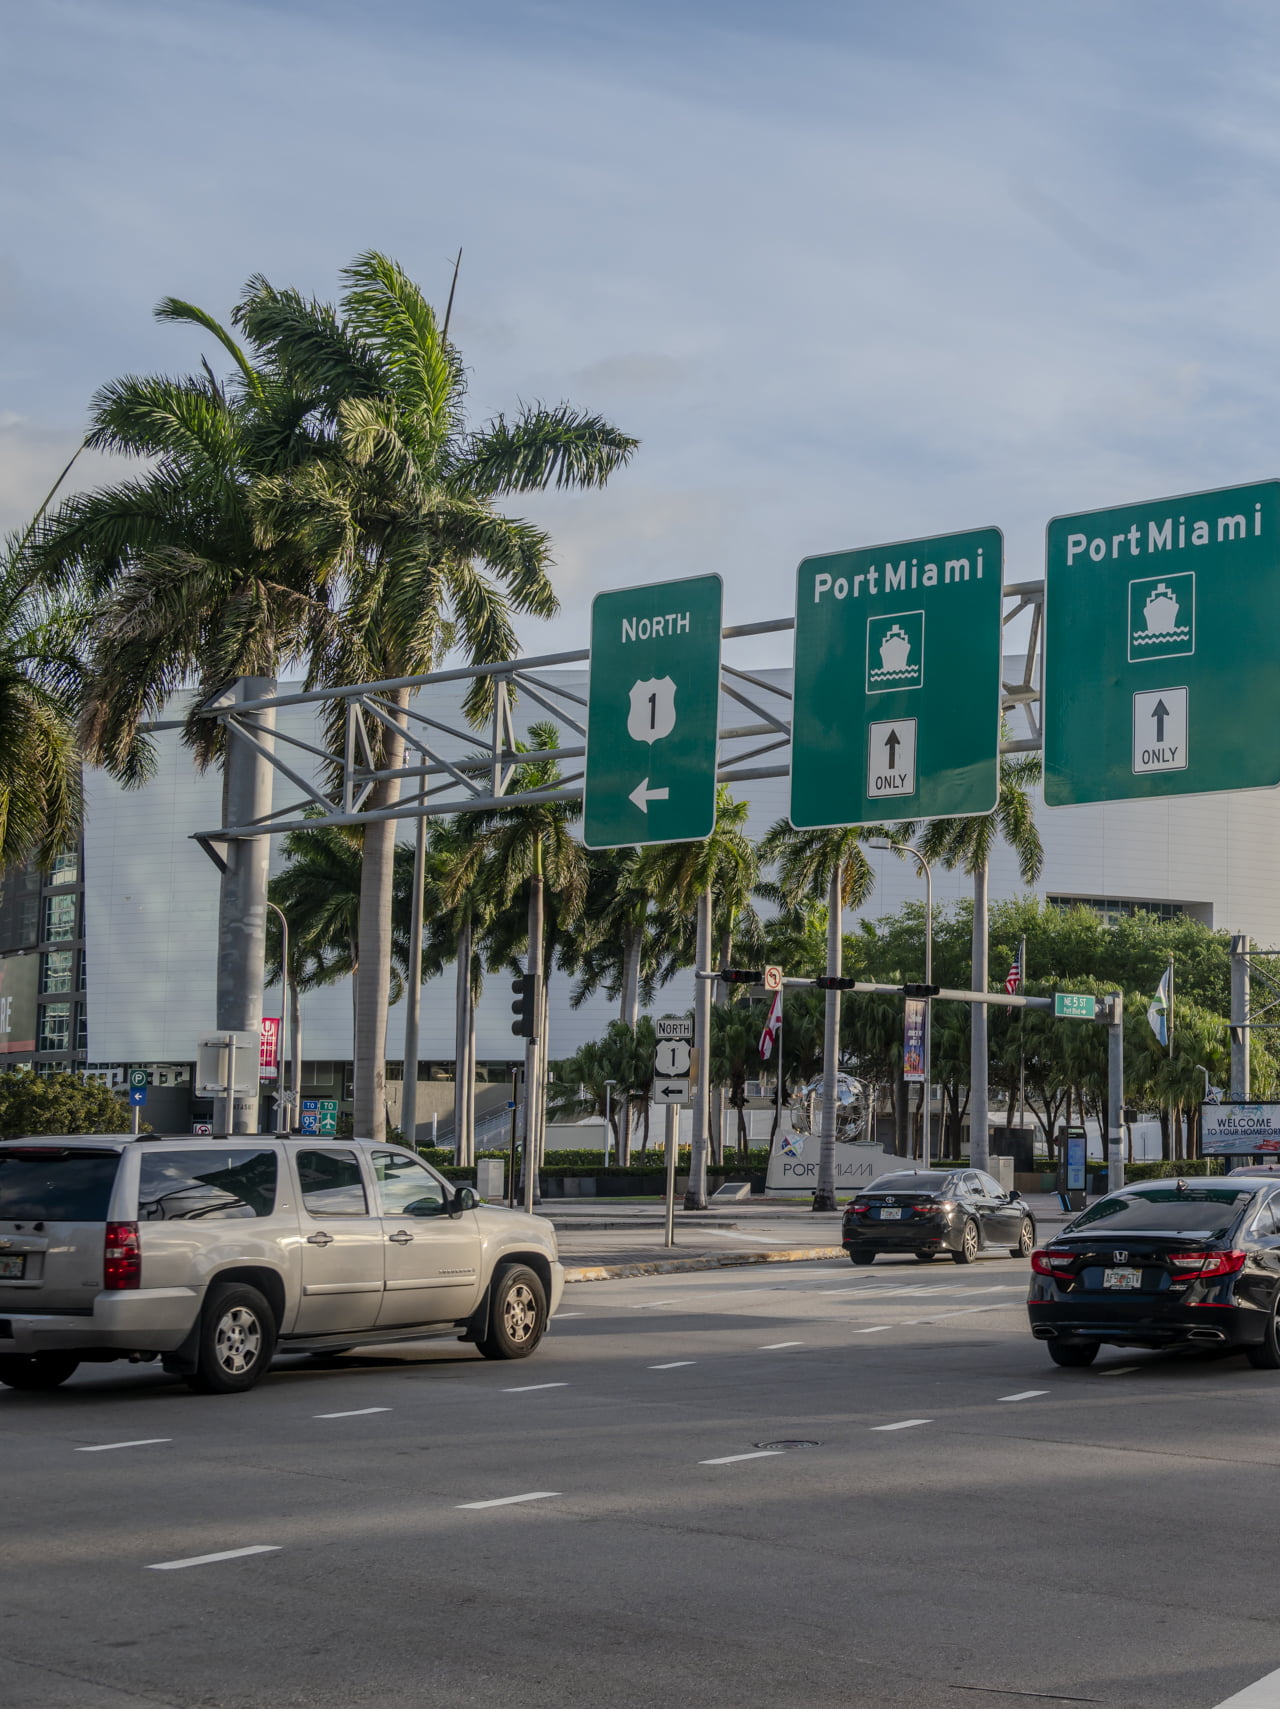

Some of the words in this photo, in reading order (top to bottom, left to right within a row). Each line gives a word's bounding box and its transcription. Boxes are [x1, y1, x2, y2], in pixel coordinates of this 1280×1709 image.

[1067, 503, 1262, 566] PortMiami
[814, 548, 983, 603] PortMiami
[622, 612, 690, 643] NORTH
[649, 693, 657, 730] 1
[1142, 746, 1178, 765] ONLY
[875, 774, 907, 790] ONLY
[1063, 997, 1072, 1006] NE
[1073, 997, 1078, 1007] 5
[1080, 998, 1087, 1007] ST
[659, 1022, 690, 1035] NORTH
[670, 1047, 676, 1067] 1
[135, 1074, 142, 1083] P
[324, 1102, 334, 1110] TO
[303, 1116, 315, 1127] 95
[1217, 1118, 1272, 1128] WELCOME
[1207, 1128, 1217, 1136] TO
[1219, 1128, 1239, 1136] YOUR
